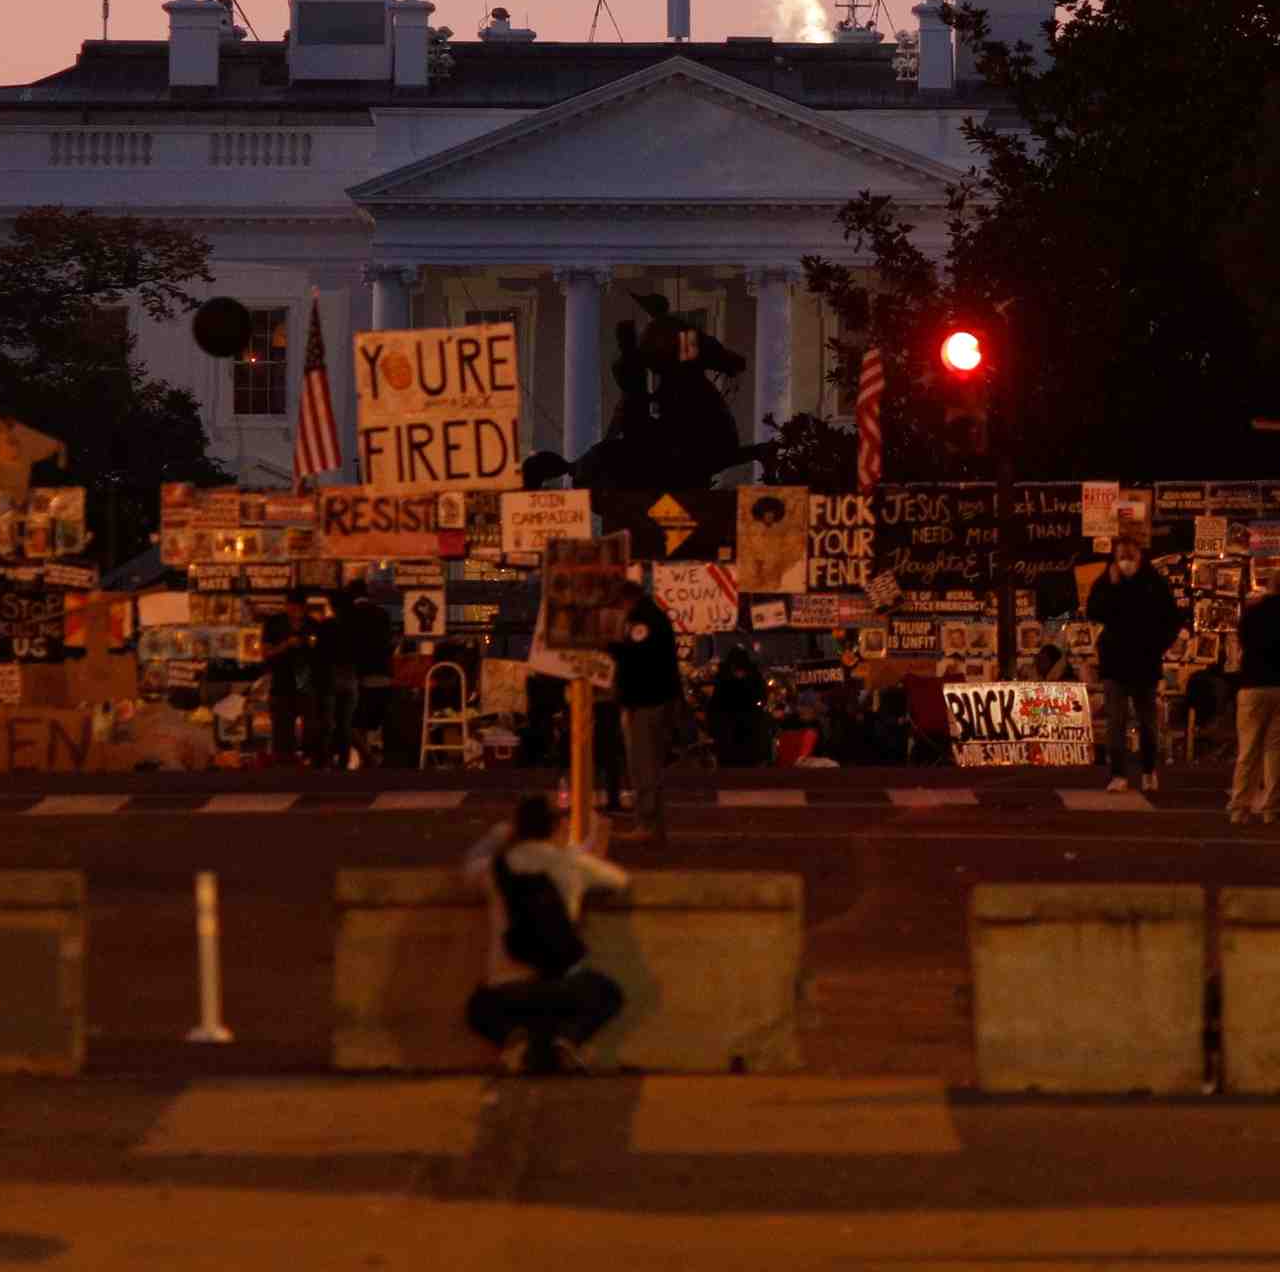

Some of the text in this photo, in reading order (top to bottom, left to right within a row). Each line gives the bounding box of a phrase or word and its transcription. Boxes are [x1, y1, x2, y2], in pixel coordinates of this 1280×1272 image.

[324, 495, 435, 534] RESIST
[809, 494, 876, 525] FUCK
[809, 528, 875, 557] YOUR
[912, 526, 953, 544] NEED
[672, 569, 699, 584] WE
[13, 637, 48, 658] US
[947, 689, 1022, 741] BLACK
